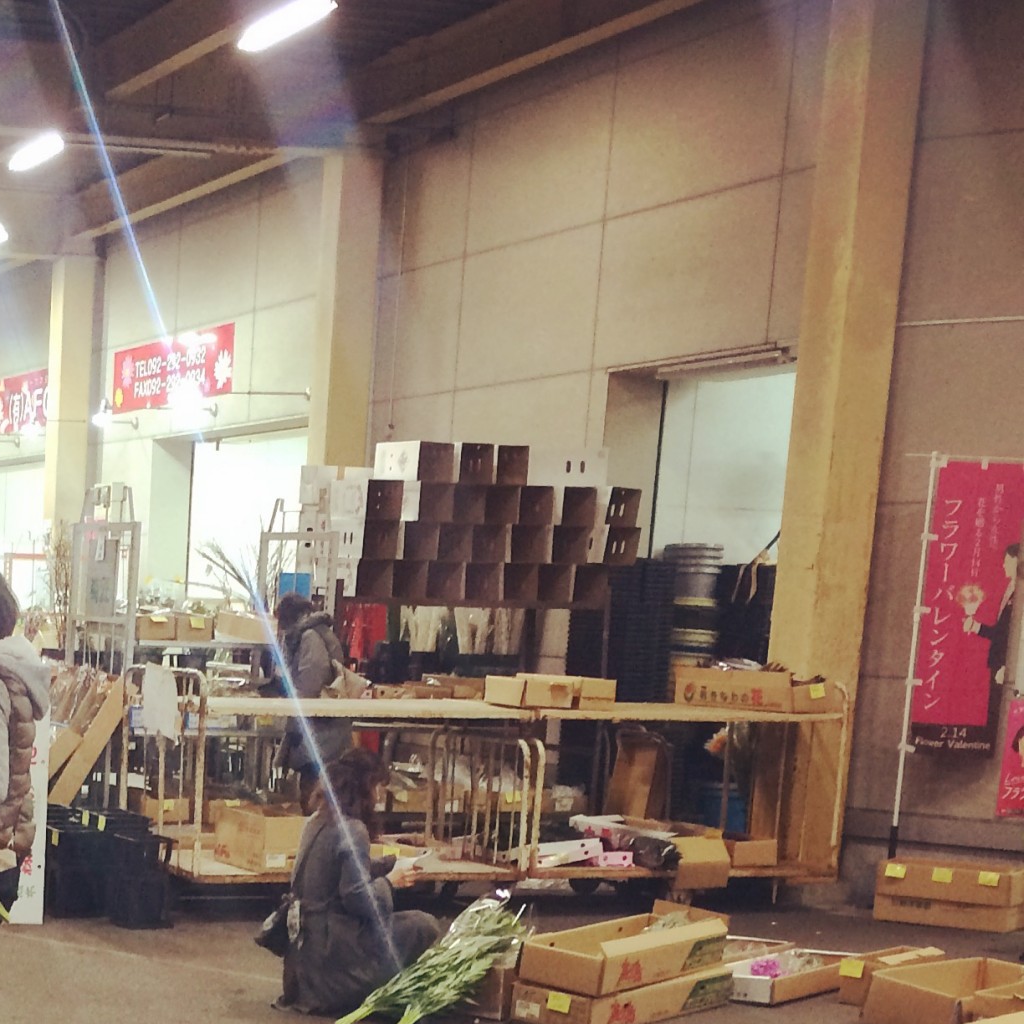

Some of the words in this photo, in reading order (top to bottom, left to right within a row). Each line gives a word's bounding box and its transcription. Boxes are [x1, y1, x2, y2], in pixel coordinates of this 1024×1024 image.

[923, 499, 962, 710] フラワーバレンタイン
[947, 739, 991, 750] Valentine
